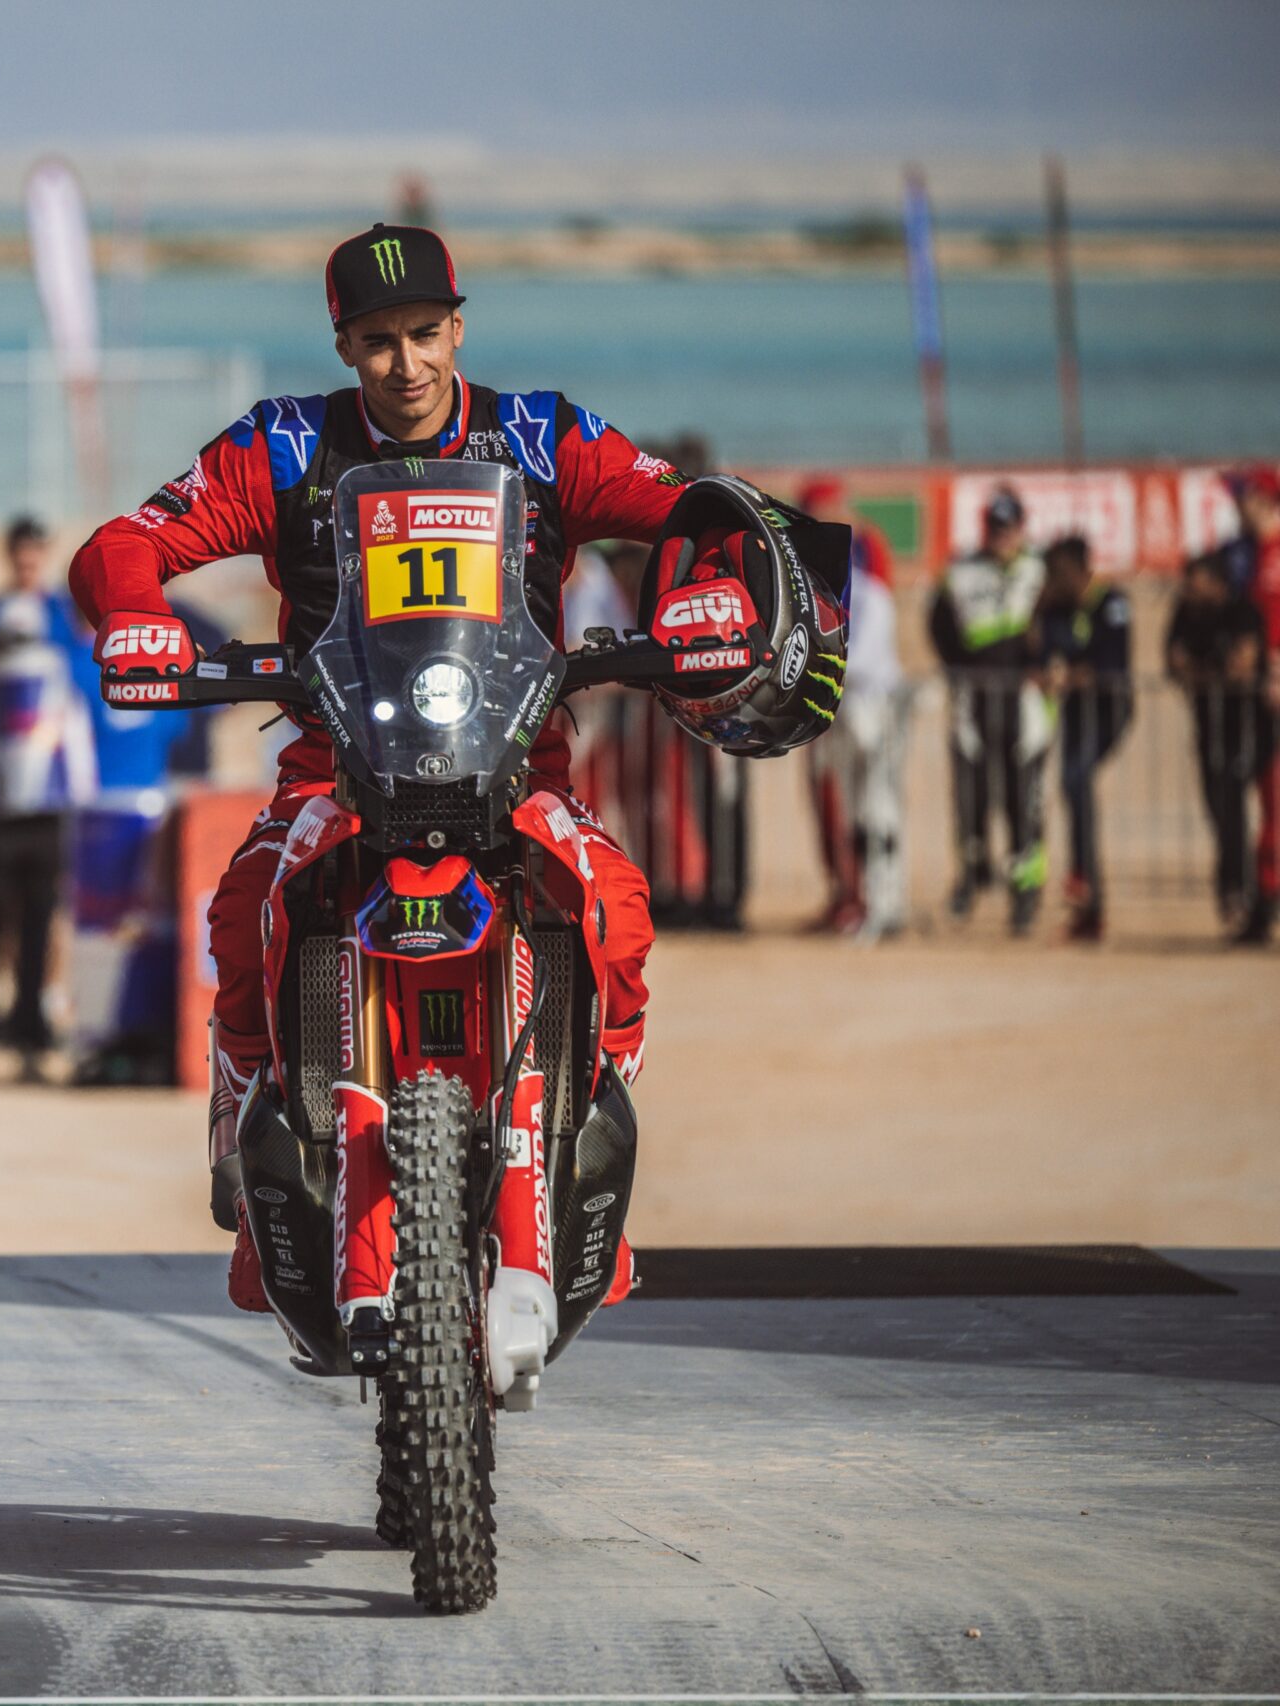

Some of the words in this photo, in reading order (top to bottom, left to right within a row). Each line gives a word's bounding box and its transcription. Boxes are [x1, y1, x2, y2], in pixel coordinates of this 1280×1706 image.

[371, 522, 399, 535] DAKAR
[413, 508, 491, 527] MOTUL
[376, 534, 394, 542] 2023
[397, 547, 467, 608] 11
[660, 594, 744, 628] GIVI
[102, 627, 182, 659] GIVI
[681, 650, 747, 670] MOTUL
[785, 629, 806, 686] Arai
[108, 684, 172, 700] MOTUL
[288, 808, 326, 849] OTUL
[391, 931, 448, 941] HONDA
[531, 1100, 550, 1277] HONDA
